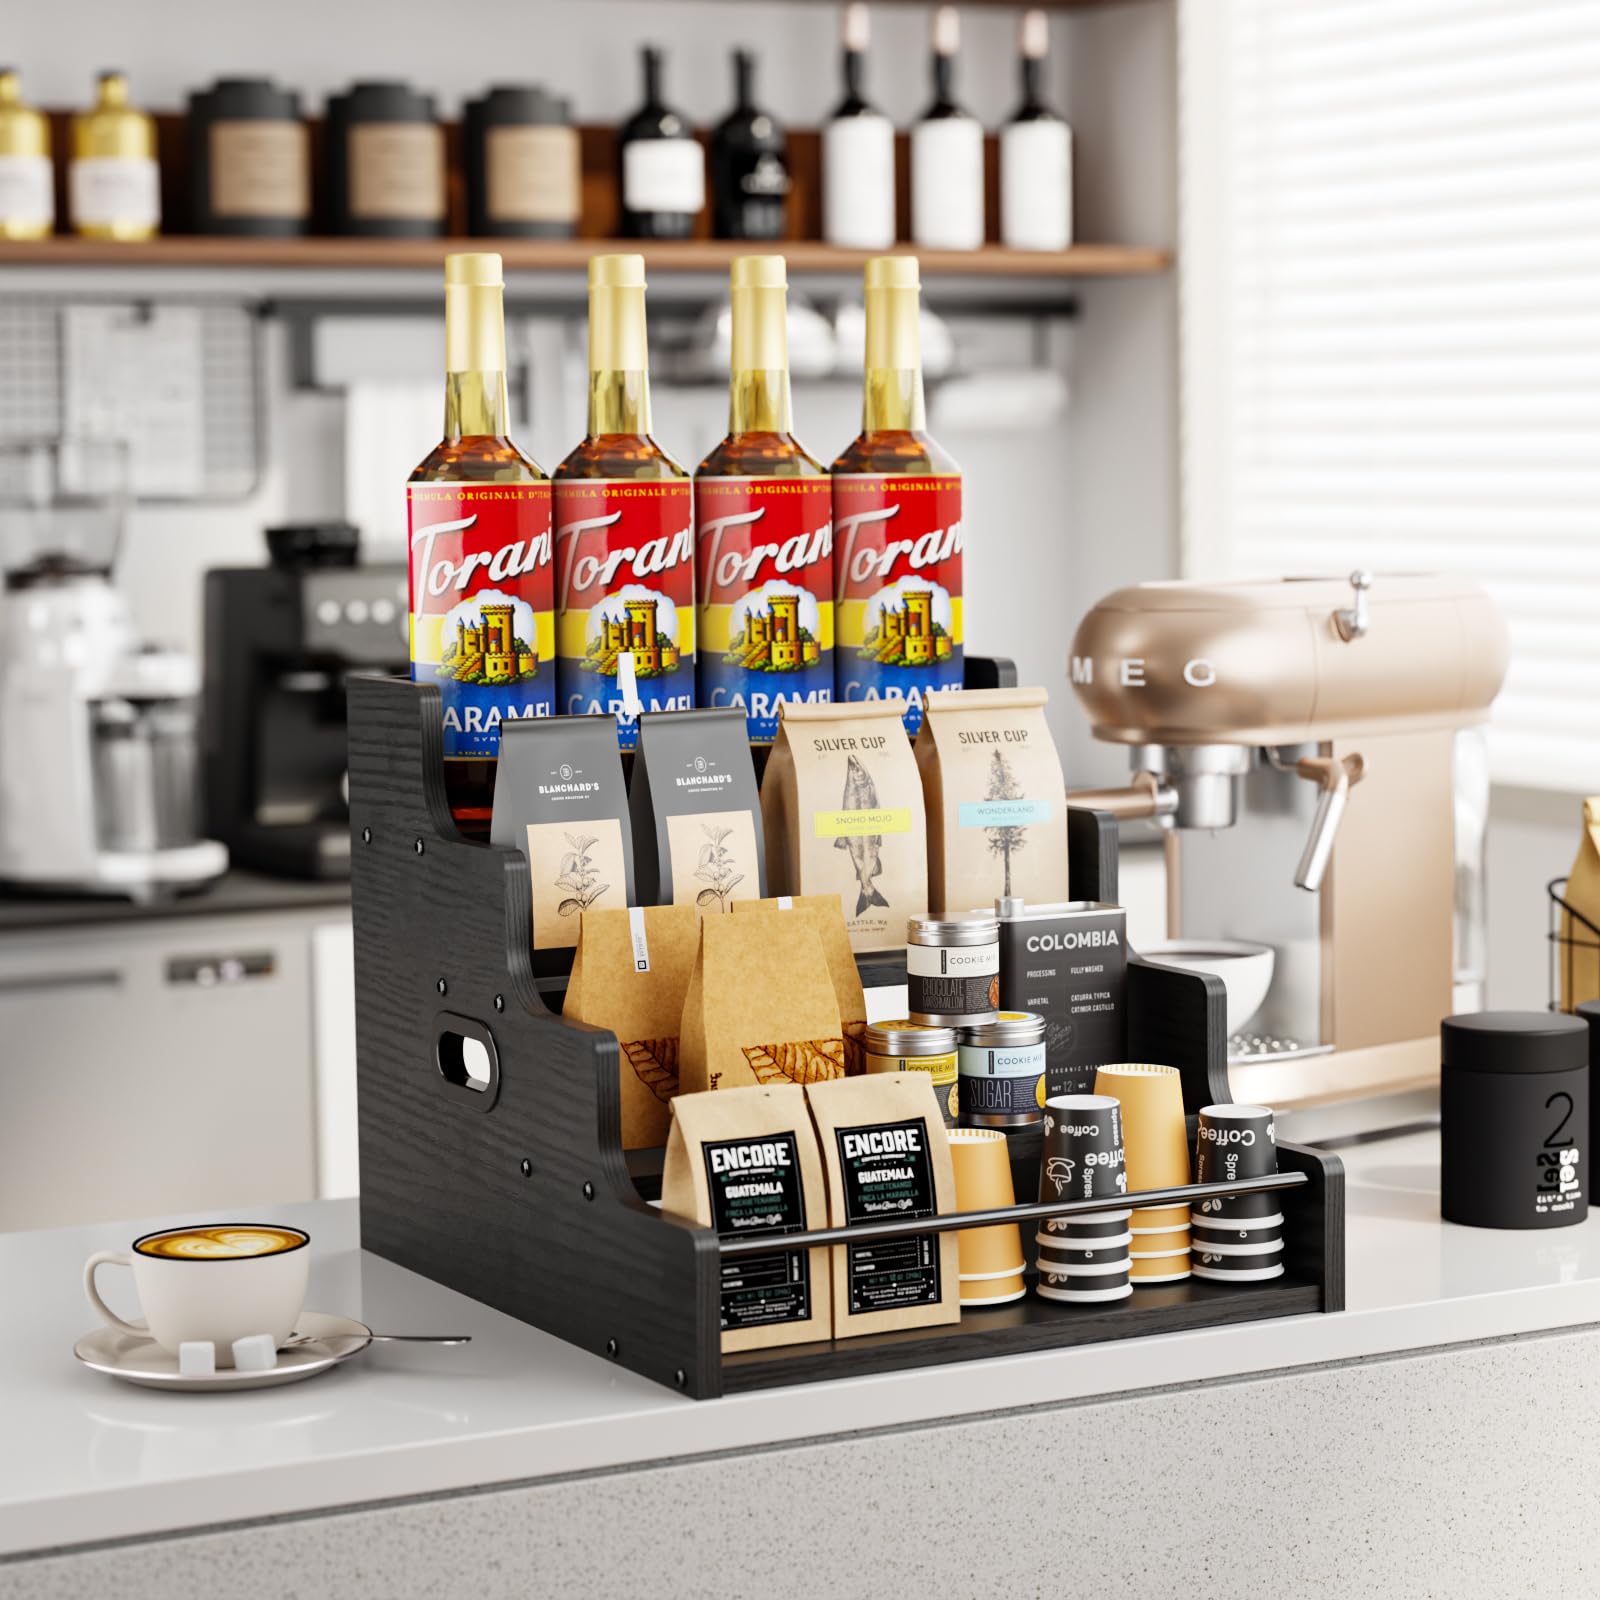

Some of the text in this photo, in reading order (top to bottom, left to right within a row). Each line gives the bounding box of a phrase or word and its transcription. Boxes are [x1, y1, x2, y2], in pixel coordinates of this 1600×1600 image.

[457, 491, 524, 501] ORIGINALE
[602, 487, 667, 497] ORIGINALE
[813, 736, 886, 752] SILVER CUP
[958, 729, 1029, 744] SILVER CUP
[675, 773, 733, 786] BLANCHARD'S
[538, 782, 600, 794] BLANCHARD'S
[977, 806, 1035, 816] WONDERLAND
[836, 814, 893, 825] SNOHO MOJO
[1026, 929, 1119, 953] COLOMBIA
[949, 955, 984, 965] COOKIE
[1026, 968, 1057, 979] PROCESSING
[998, 1057, 1031, 1065] COOKIE
[970, 1079, 1012, 1108] SUGAR
[1063, 1080, 1073, 1093] 12
[1543, 1091, 1574, 1149] 2
[1060, 1124, 1100, 1137] Coffee
[1201, 1126, 1256, 1147] Coffee
[843, 1128, 922, 1159] ENCORE
[710, 1142, 792, 1174] ENCORE
[1084, 1148, 1125, 1169] offee
[1224, 1153, 1239, 1180] Spre
[857, 1166, 915, 1184] GUATEMALA
[1082, 1167, 1095, 1198] Spres
[724, 1181, 784, 1199] GUATEMALA
